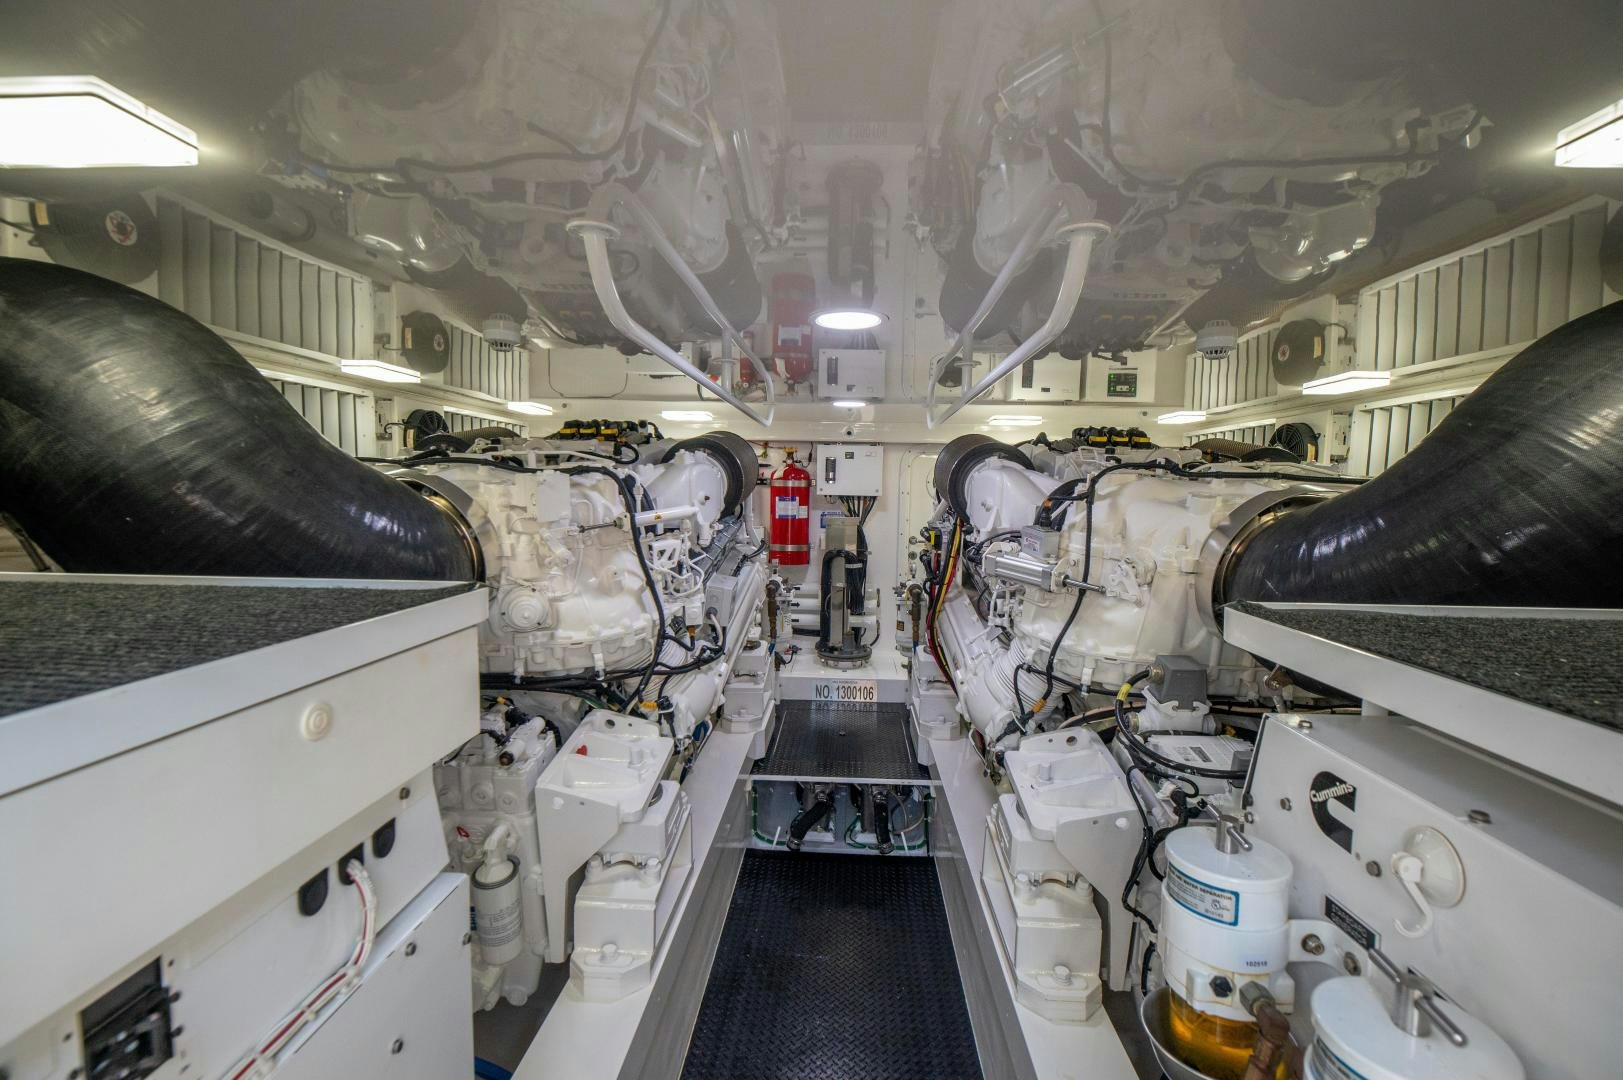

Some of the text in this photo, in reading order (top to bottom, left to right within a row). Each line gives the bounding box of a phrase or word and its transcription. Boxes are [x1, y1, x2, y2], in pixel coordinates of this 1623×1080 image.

[815, 684, 874, 700] NO. 1300106
[1310, 781, 1354, 802] Cummins
